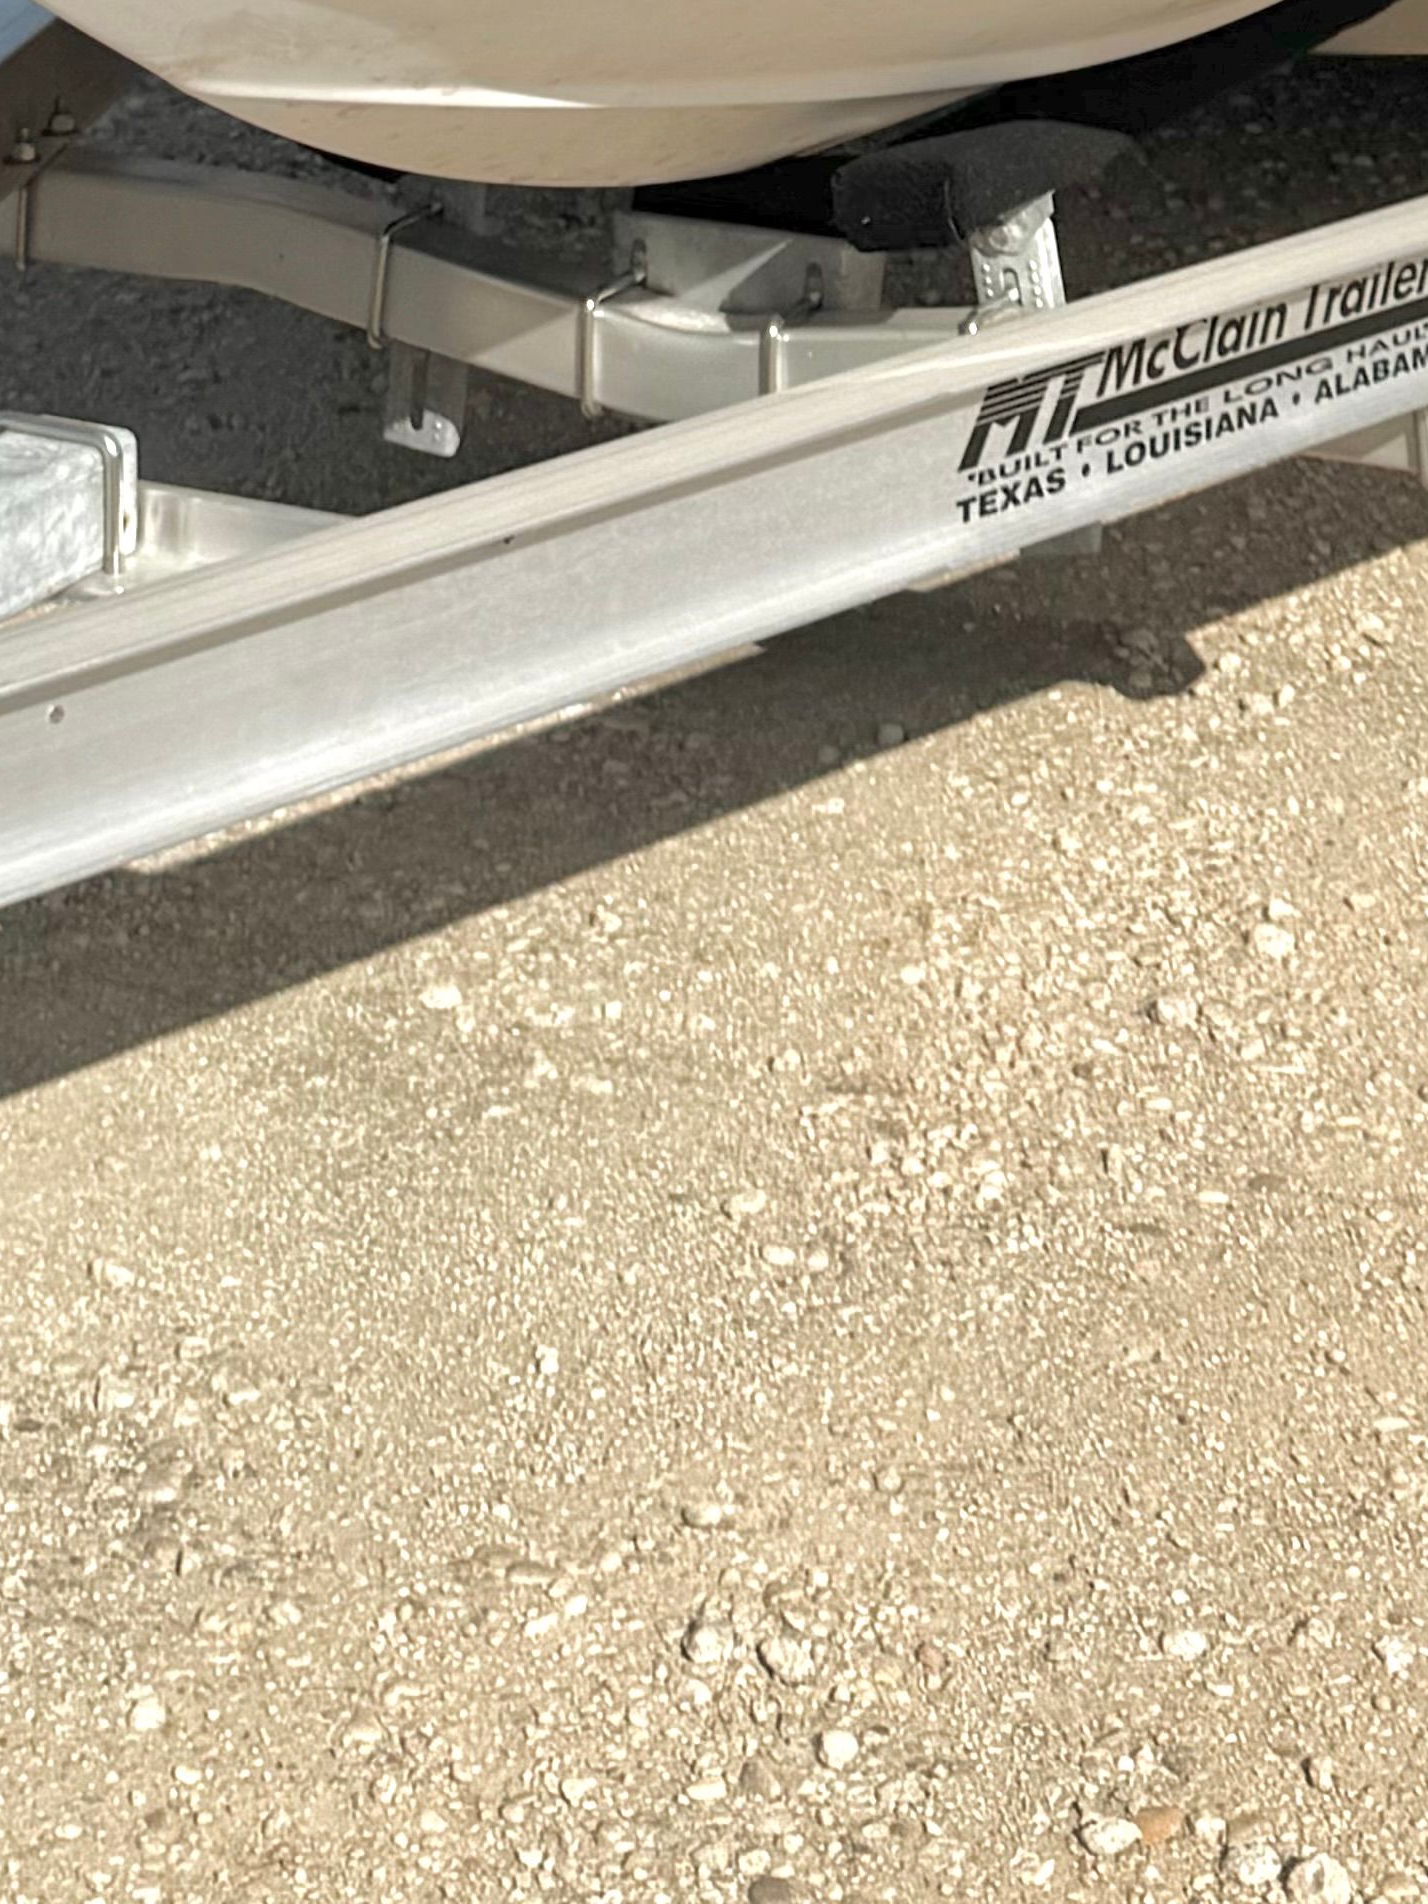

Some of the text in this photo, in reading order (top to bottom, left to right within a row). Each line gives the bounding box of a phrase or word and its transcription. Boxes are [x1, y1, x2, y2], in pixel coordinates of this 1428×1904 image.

[1096, 301, 1289, 399] McClain
[1076, 420, 1144, 454] FOR
[1151, 395, 1211, 428] THE
[1223, 356, 1335, 405] LONG
[956, 467, 1067, 524] TEXAS
[1105, 396, 1280, 475] LOUISIANA
